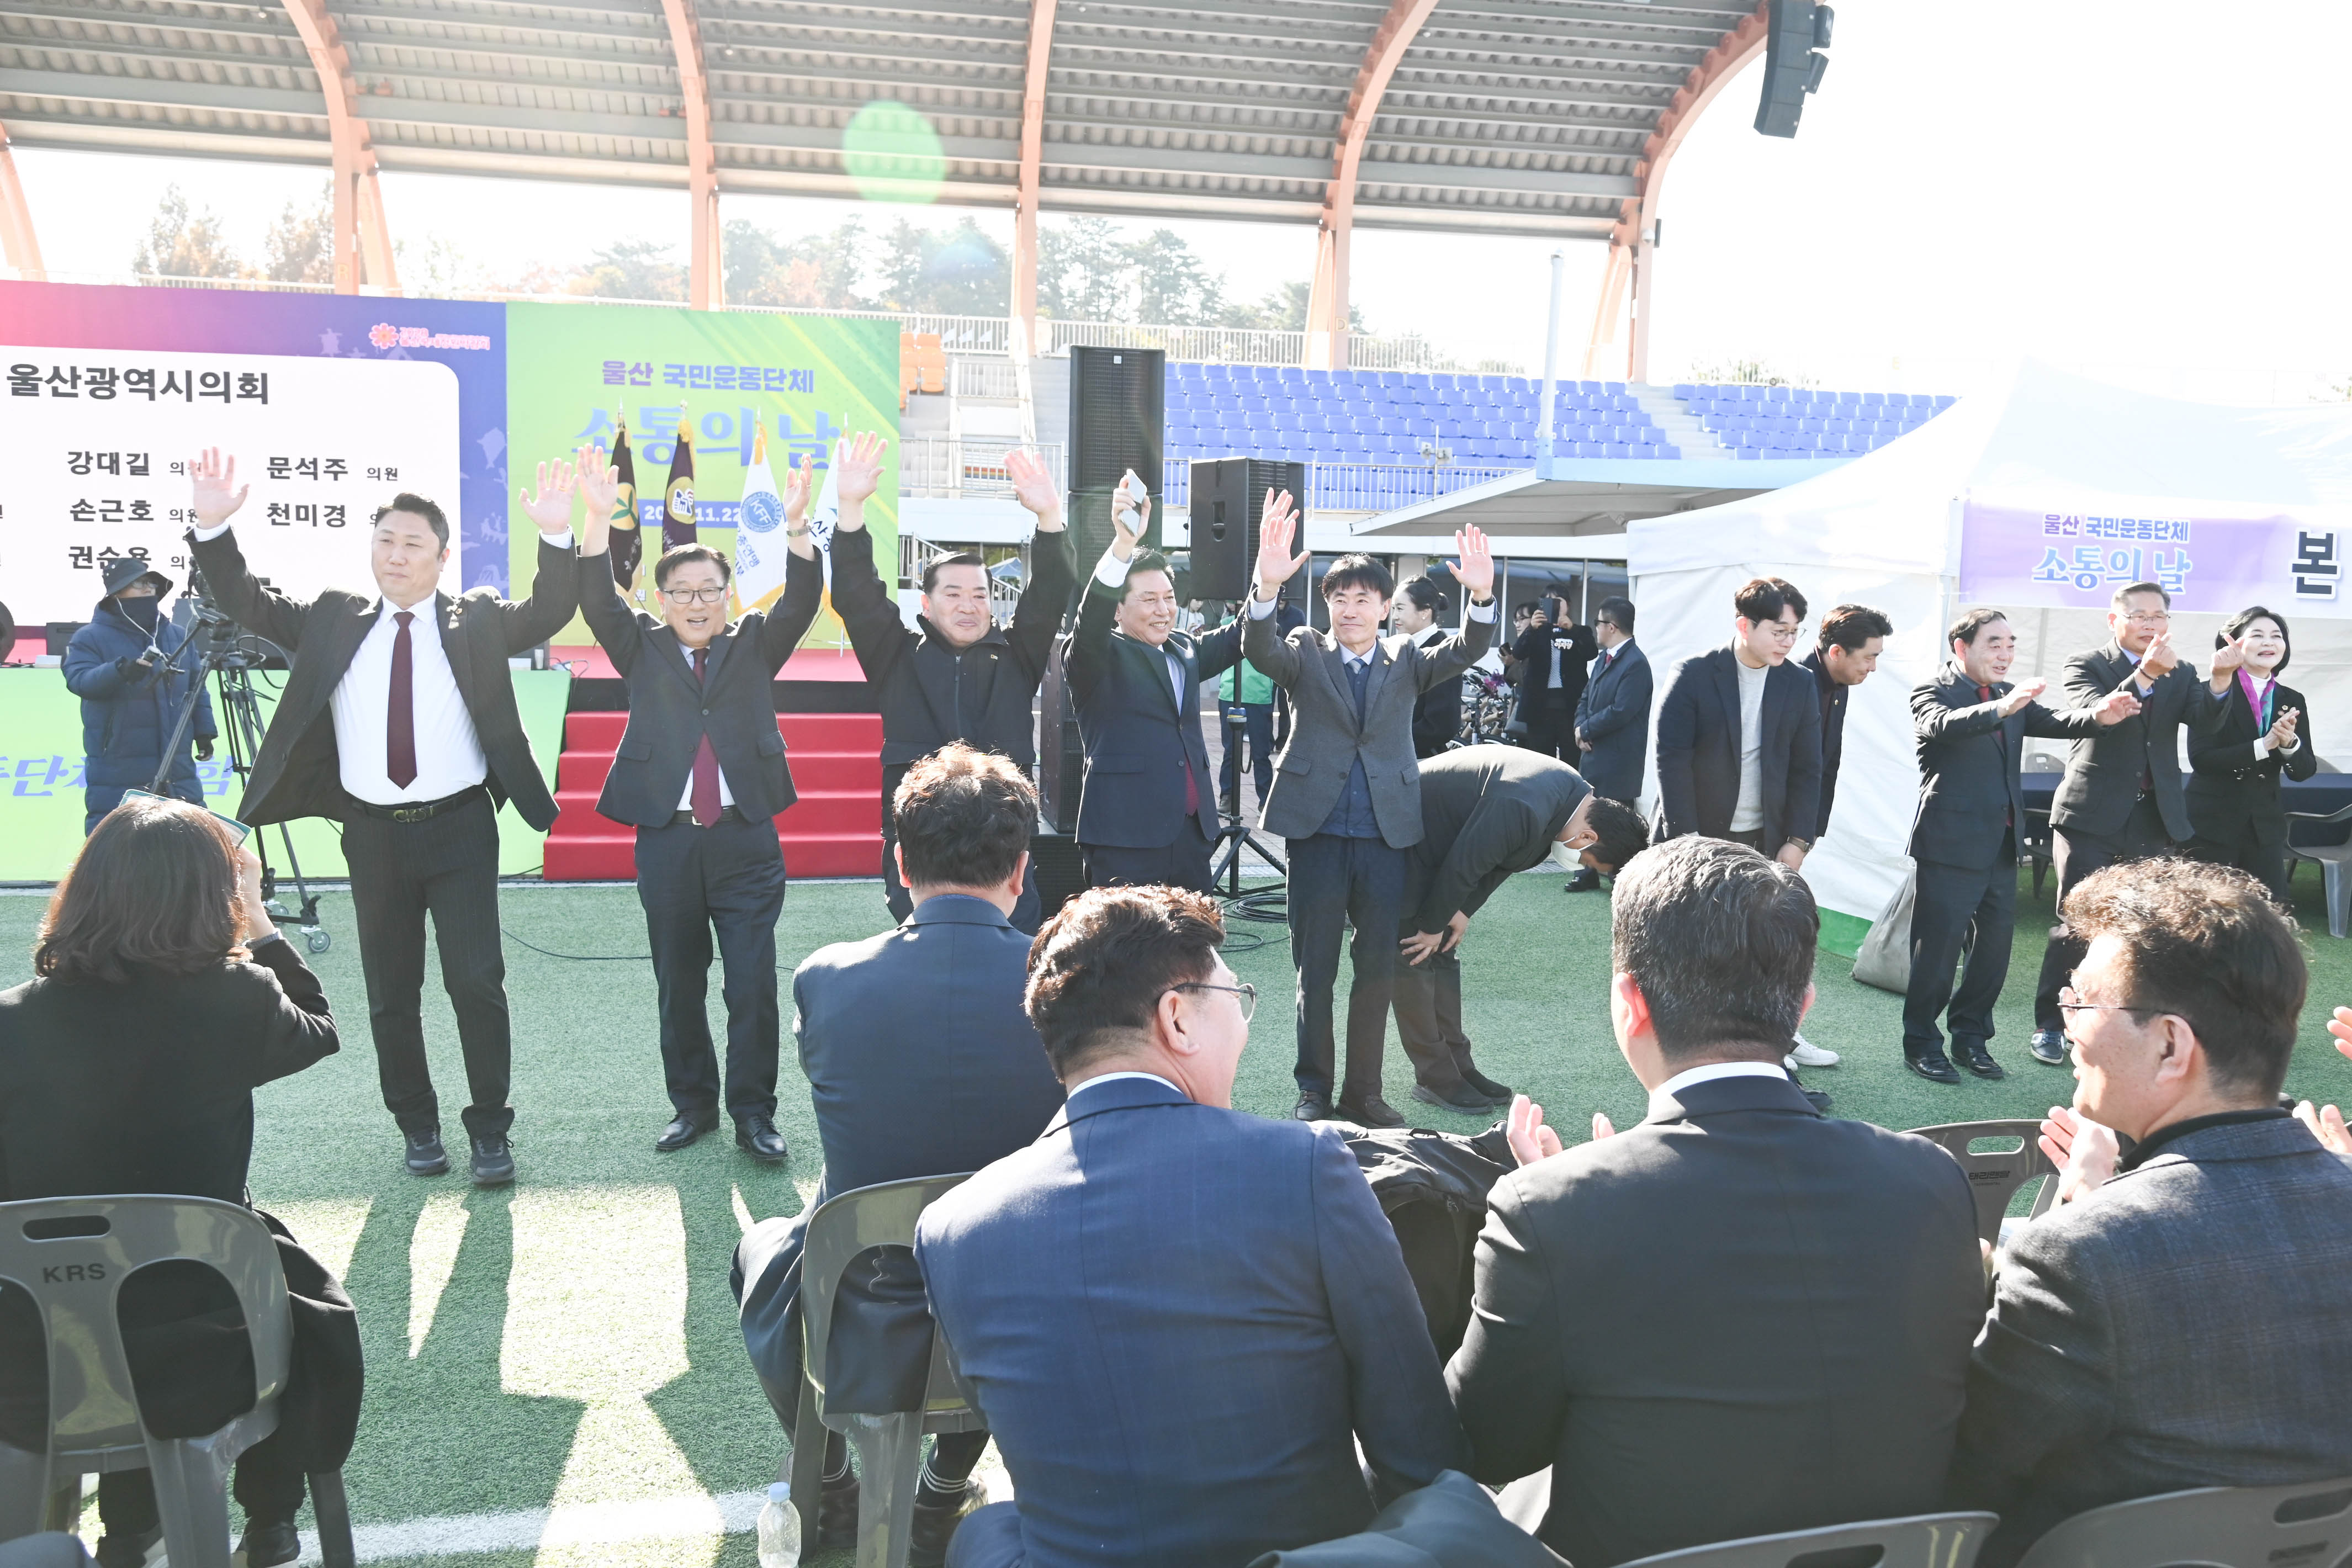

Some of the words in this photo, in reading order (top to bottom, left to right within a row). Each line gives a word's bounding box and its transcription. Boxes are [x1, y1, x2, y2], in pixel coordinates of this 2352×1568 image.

[1336, 317, 1348, 331] D
[7, 363, 268, 405] 울산광역시의회
[602, 361, 653, 386] 울산
[663, 363, 814, 393] 국민운동단체
[778, 409, 841, 469] 날
[67, 451, 150, 476] 강대길
[267, 457, 348, 481] 문석주
[367, 467, 398, 481] 의원
[70, 499, 154, 522] 손근호
[267, 502, 346, 527] 천미경
[750, 499, 772, 524] KFF
[2044, 514, 2080, 536] 울산
[2086, 516, 2189, 542] 국민운동단체
[2033, 546, 2143, 590] 소통의
[2155, 548, 2191, 592] 날
[2292, 531, 2338, 595] 본
[44, 1263, 106, 1284] KRS
